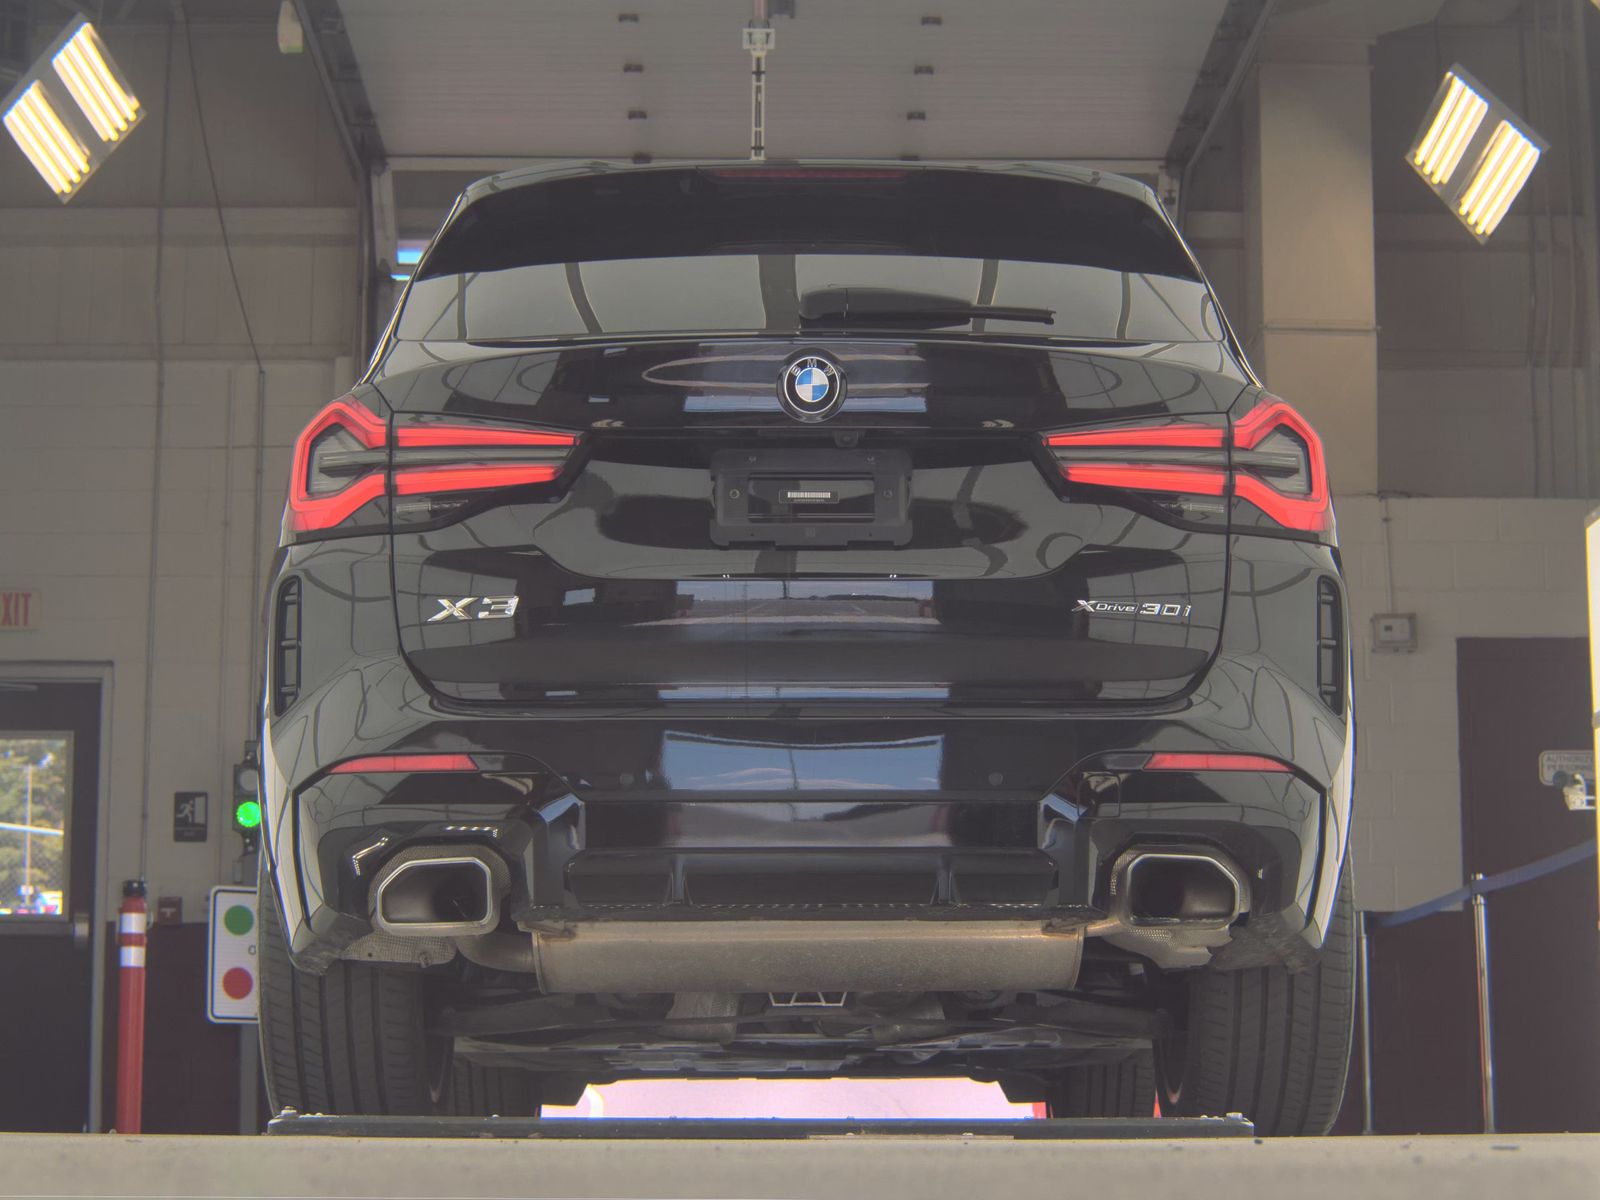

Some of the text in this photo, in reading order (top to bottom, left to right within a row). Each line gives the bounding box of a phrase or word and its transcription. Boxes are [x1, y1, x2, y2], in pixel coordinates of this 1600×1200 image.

[790, 357, 835, 377] BMW
[0, 591, 32, 626] XIT
[426, 595, 520, 622] X3
